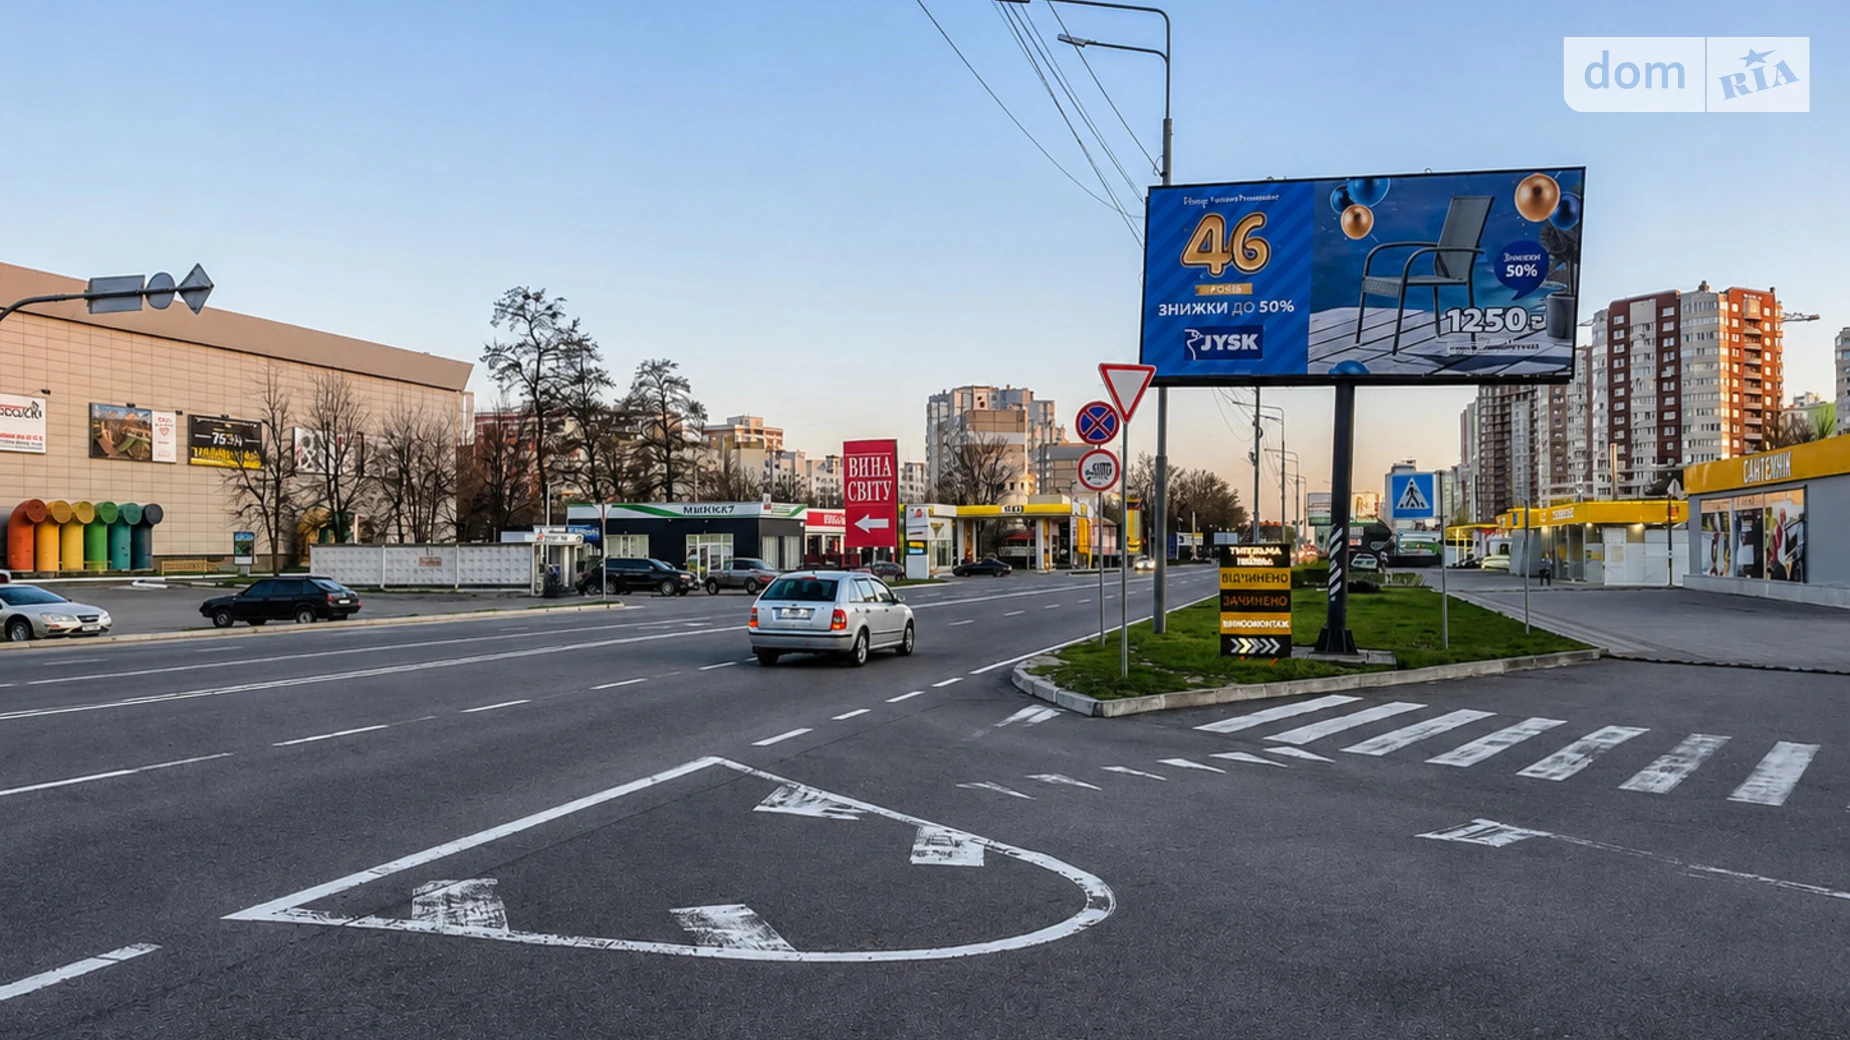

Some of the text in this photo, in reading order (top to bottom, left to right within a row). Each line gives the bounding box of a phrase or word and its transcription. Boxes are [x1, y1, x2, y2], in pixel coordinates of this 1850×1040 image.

[1180, 212, 1272, 278] 46
[1505, 263, 1538, 278] 50%
[1158, 299, 1296, 317] ЗНИЖКИ ДО 50%
[1200, 333, 1259, 351] JYSK
[848, 456, 892, 478] ВИНА
[847, 480, 892, 502] СВІТУ
